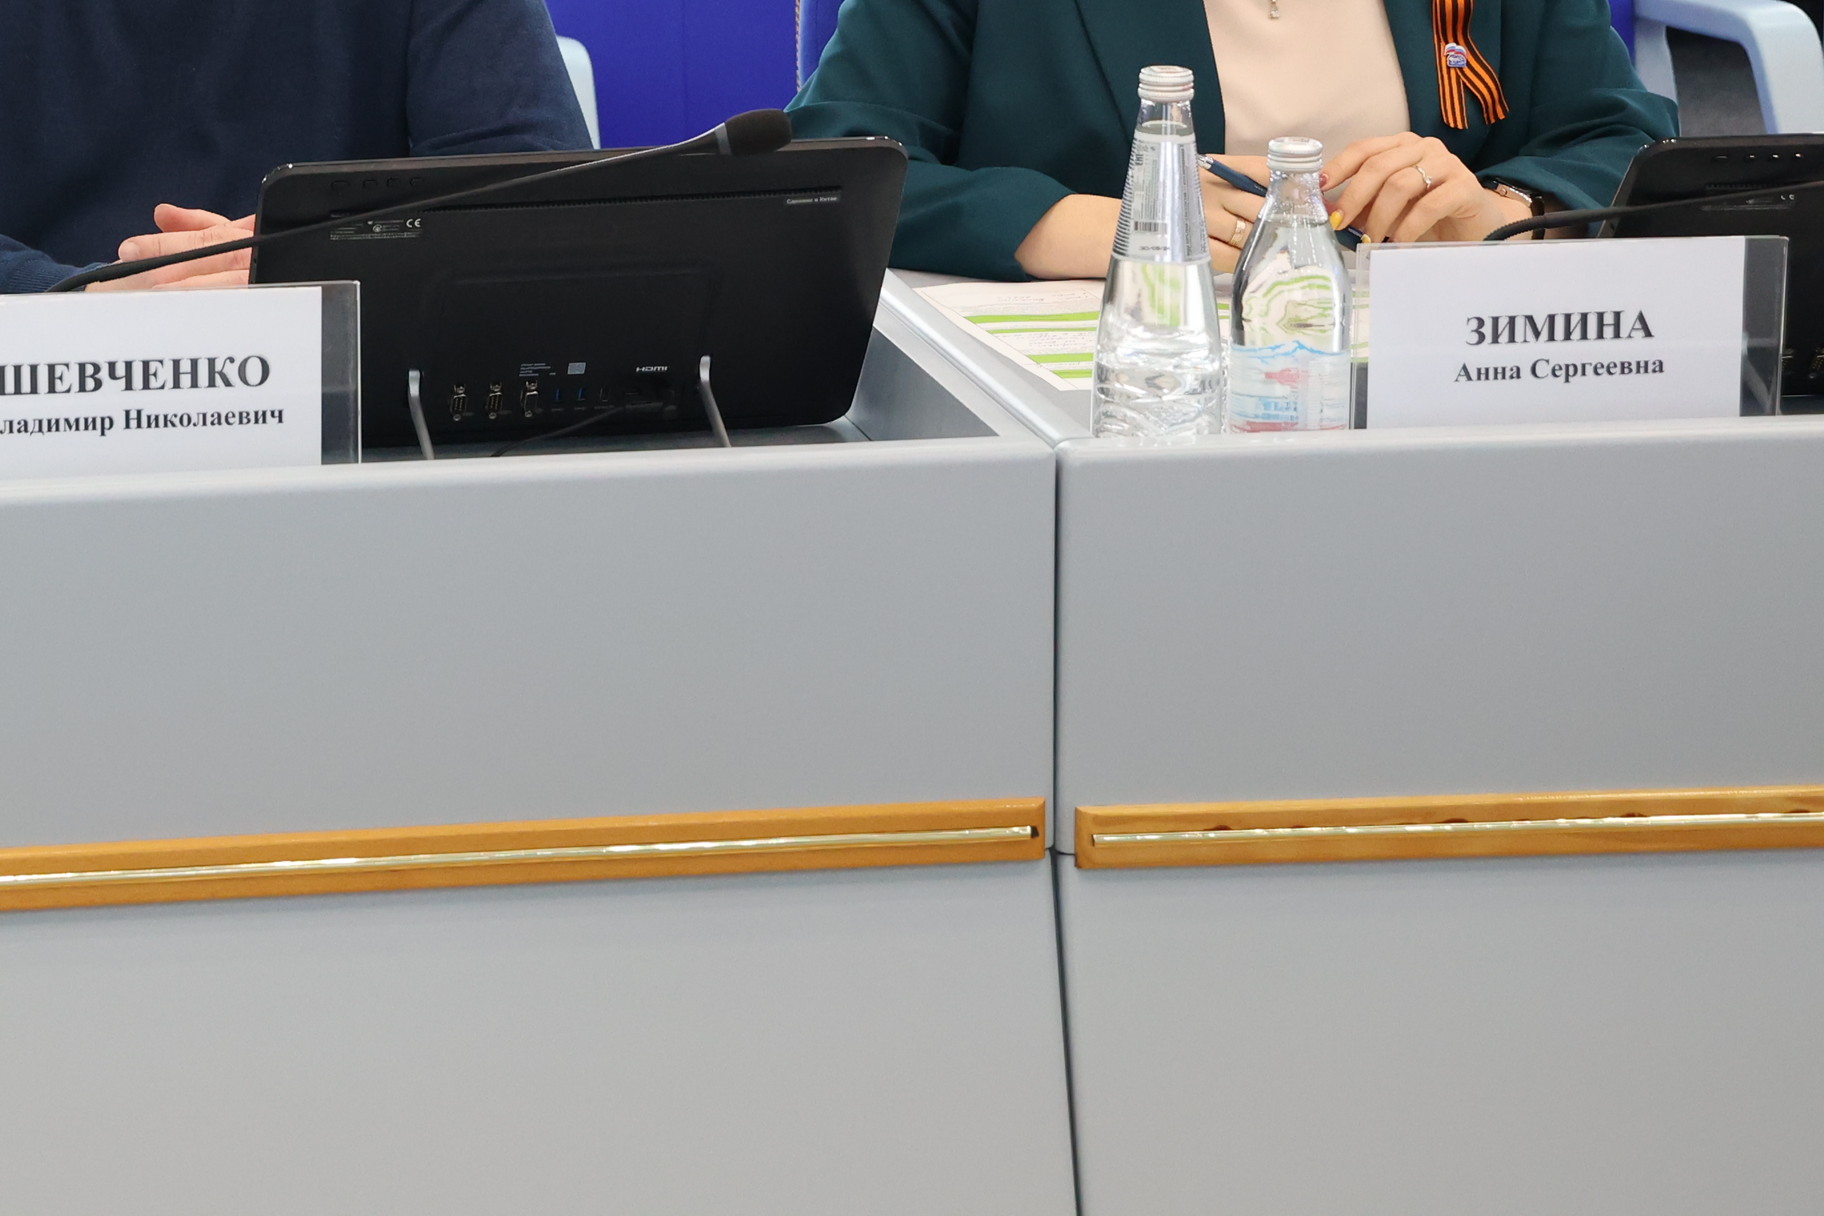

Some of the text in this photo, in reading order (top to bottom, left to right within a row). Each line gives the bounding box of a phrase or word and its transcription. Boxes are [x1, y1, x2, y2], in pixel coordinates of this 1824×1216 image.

[1465, 309, 1656, 346] ЗИМИНА
[1453, 357, 1665, 384] Анна Сергеевна
[123, 408, 285, 430] Николаевич
